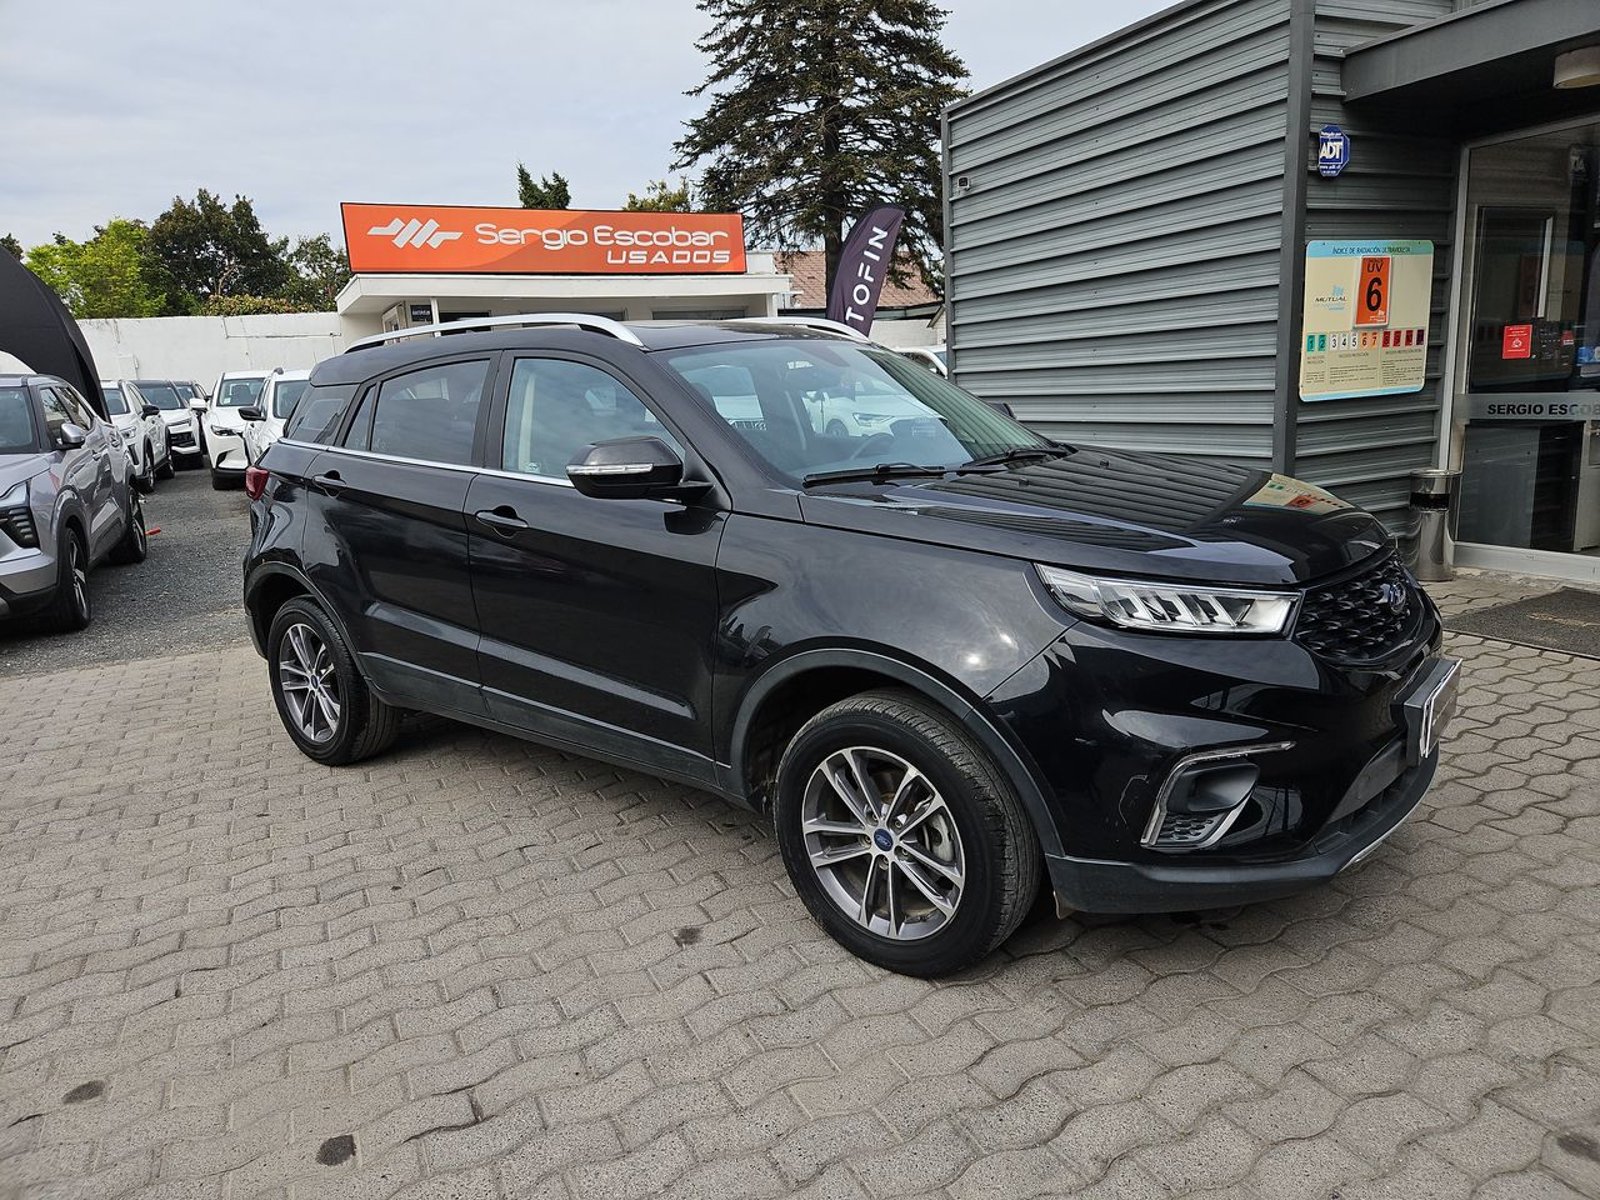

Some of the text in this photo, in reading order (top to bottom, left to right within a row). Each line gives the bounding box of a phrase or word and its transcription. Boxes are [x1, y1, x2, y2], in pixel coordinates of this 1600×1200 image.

[1319, 141, 1343, 159] ADT
[474, 223, 729, 250] Sergio Escobar
[606, 250, 731, 265] USADOS
[845, 226, 888, 321] TOFIN
[1367, 262, 1383, 273] UV
[1366, 277, 1382, 311] 6
[1331, 338, 1337, 348] 3
[1341, 338, 1347, 347] 4
[1351, 337, 1357, 347] 5
[1362, 336, 1368, 346] 6
[1372, 335, 1377, 346] 7
[1488, 404, 1544, 415] SERGIO
